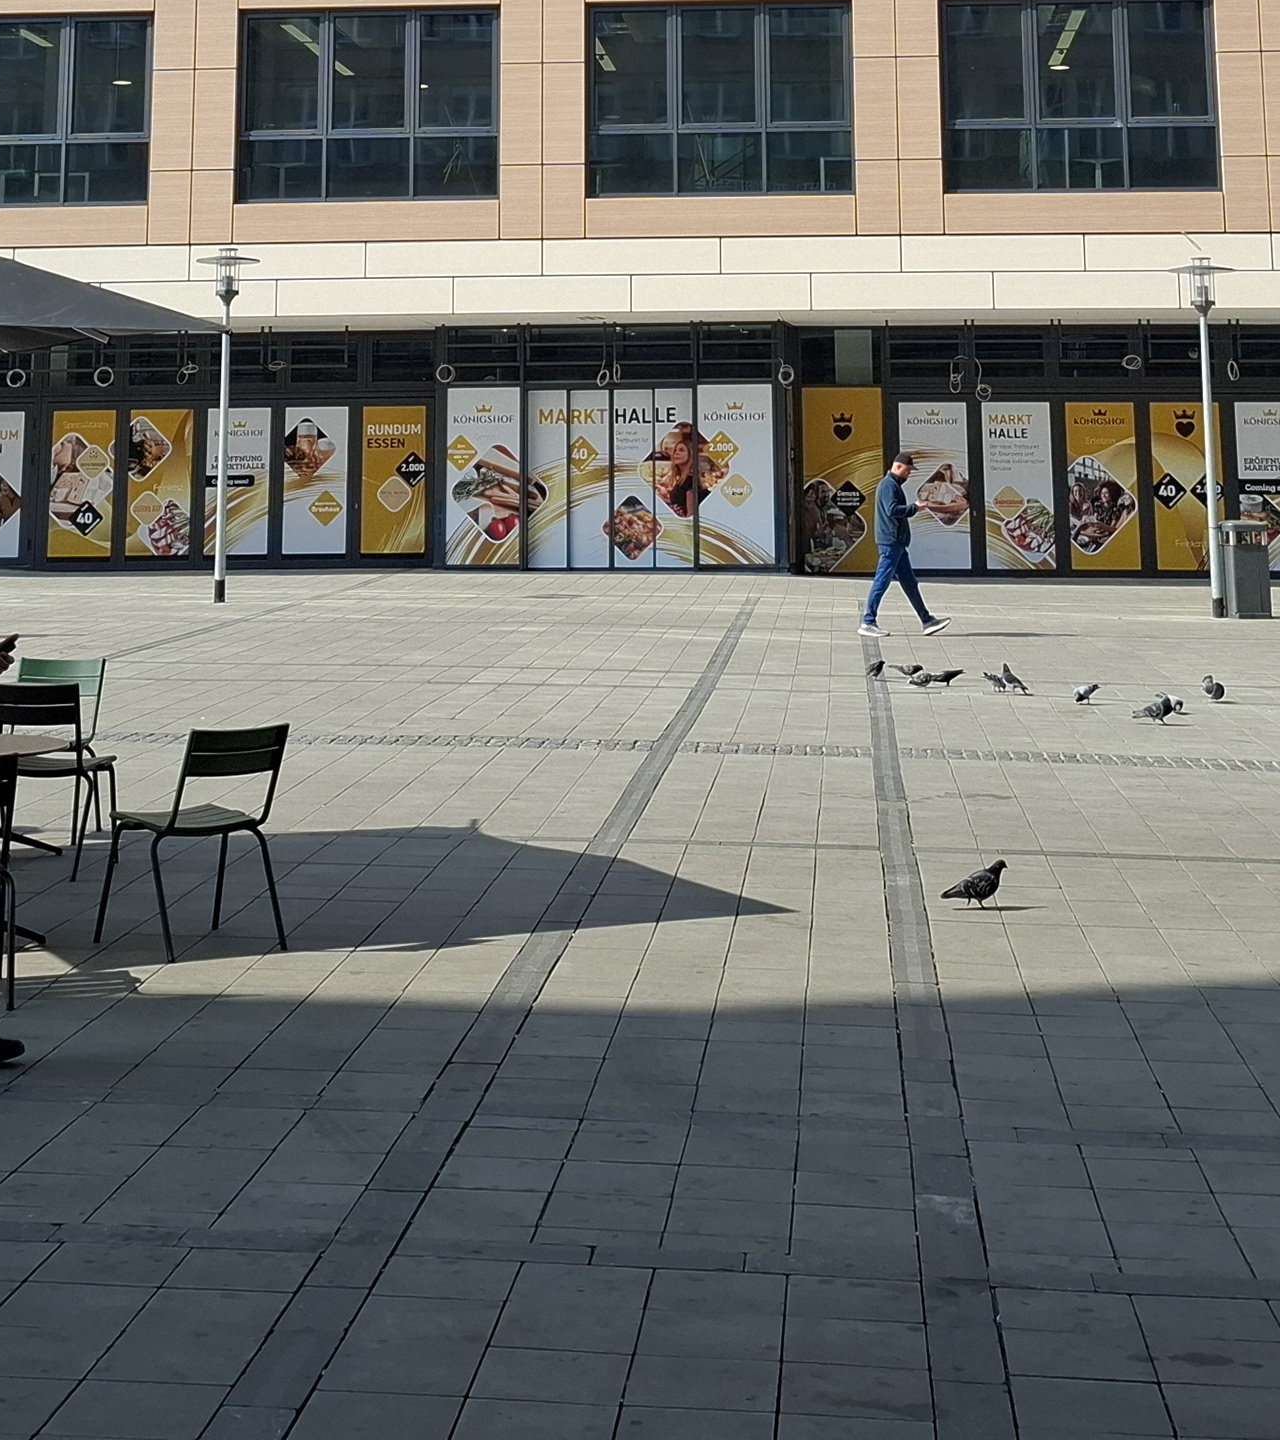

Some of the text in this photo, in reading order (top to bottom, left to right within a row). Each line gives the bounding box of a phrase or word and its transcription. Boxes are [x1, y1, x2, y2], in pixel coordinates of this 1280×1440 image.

[453, 414, 514, 424] KÖNIGSHOF
[539, 407, 677, 425] MARKT HALLE
[703, 411, 766, 422] KÖNIGSHOF
[988, 414, 1032, 425] MARKT
[907, 417, 959, 426] KÖNIGSHOF
[1074, 417, 1127, 426] KÖNIGSHOF
[214, 429, 263, 437] KNIGSHOF
[367, 424, 421, 435] RUNDUM
[989, 428, 1028, 439] HALLE
[367, 438, 405, 448] ESSEN
[709, 443, 733, 451] 2.000
[572, 448, 588, 459] 40
[401, 464, 425, 472] 2.000
[1158, 485, 1176, 496] 40
[1195, 485, 1221, 493] 2.00
[1245, 483, 1276, 492] Coming
[76, 512, 93, 524] 40
